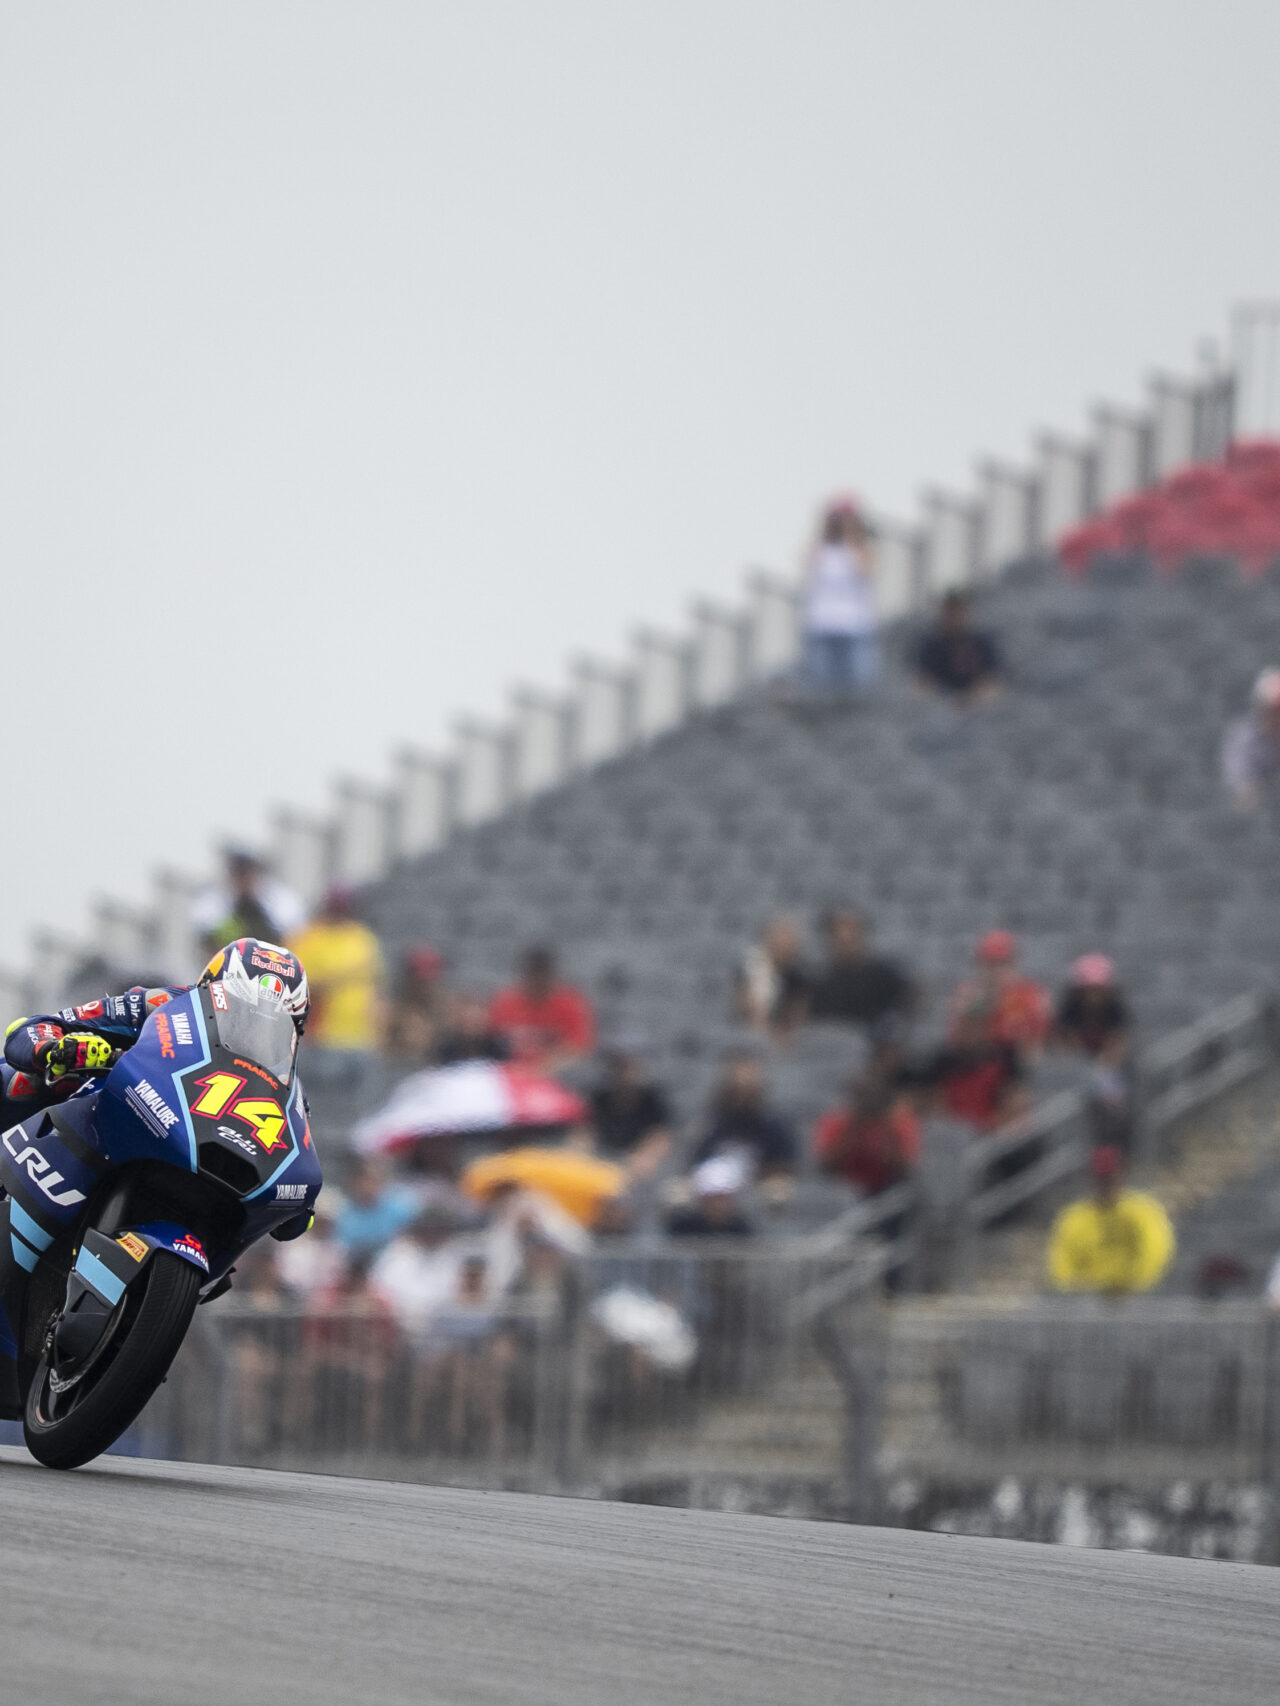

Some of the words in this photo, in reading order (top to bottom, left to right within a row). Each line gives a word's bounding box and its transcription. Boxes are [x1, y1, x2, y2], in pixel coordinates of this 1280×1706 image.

[252, 956, 273, 971] Red
[274, 963, 295, 978] Bull
[154, 1012, 175, 1059] PRAMAC
[171, 1012, 193, 1045] YAMAHA
[233, 1058, 278, 1090] PRAMAC
[134, 1079, 180, 1129] YAMALUBE
[190, 1071, 288, 1154] 14
[217, 1126, 257, 1149] BLU
[218, 1132, 257, 1155] CRU
[1, 1123, 87, 1206] CRU
